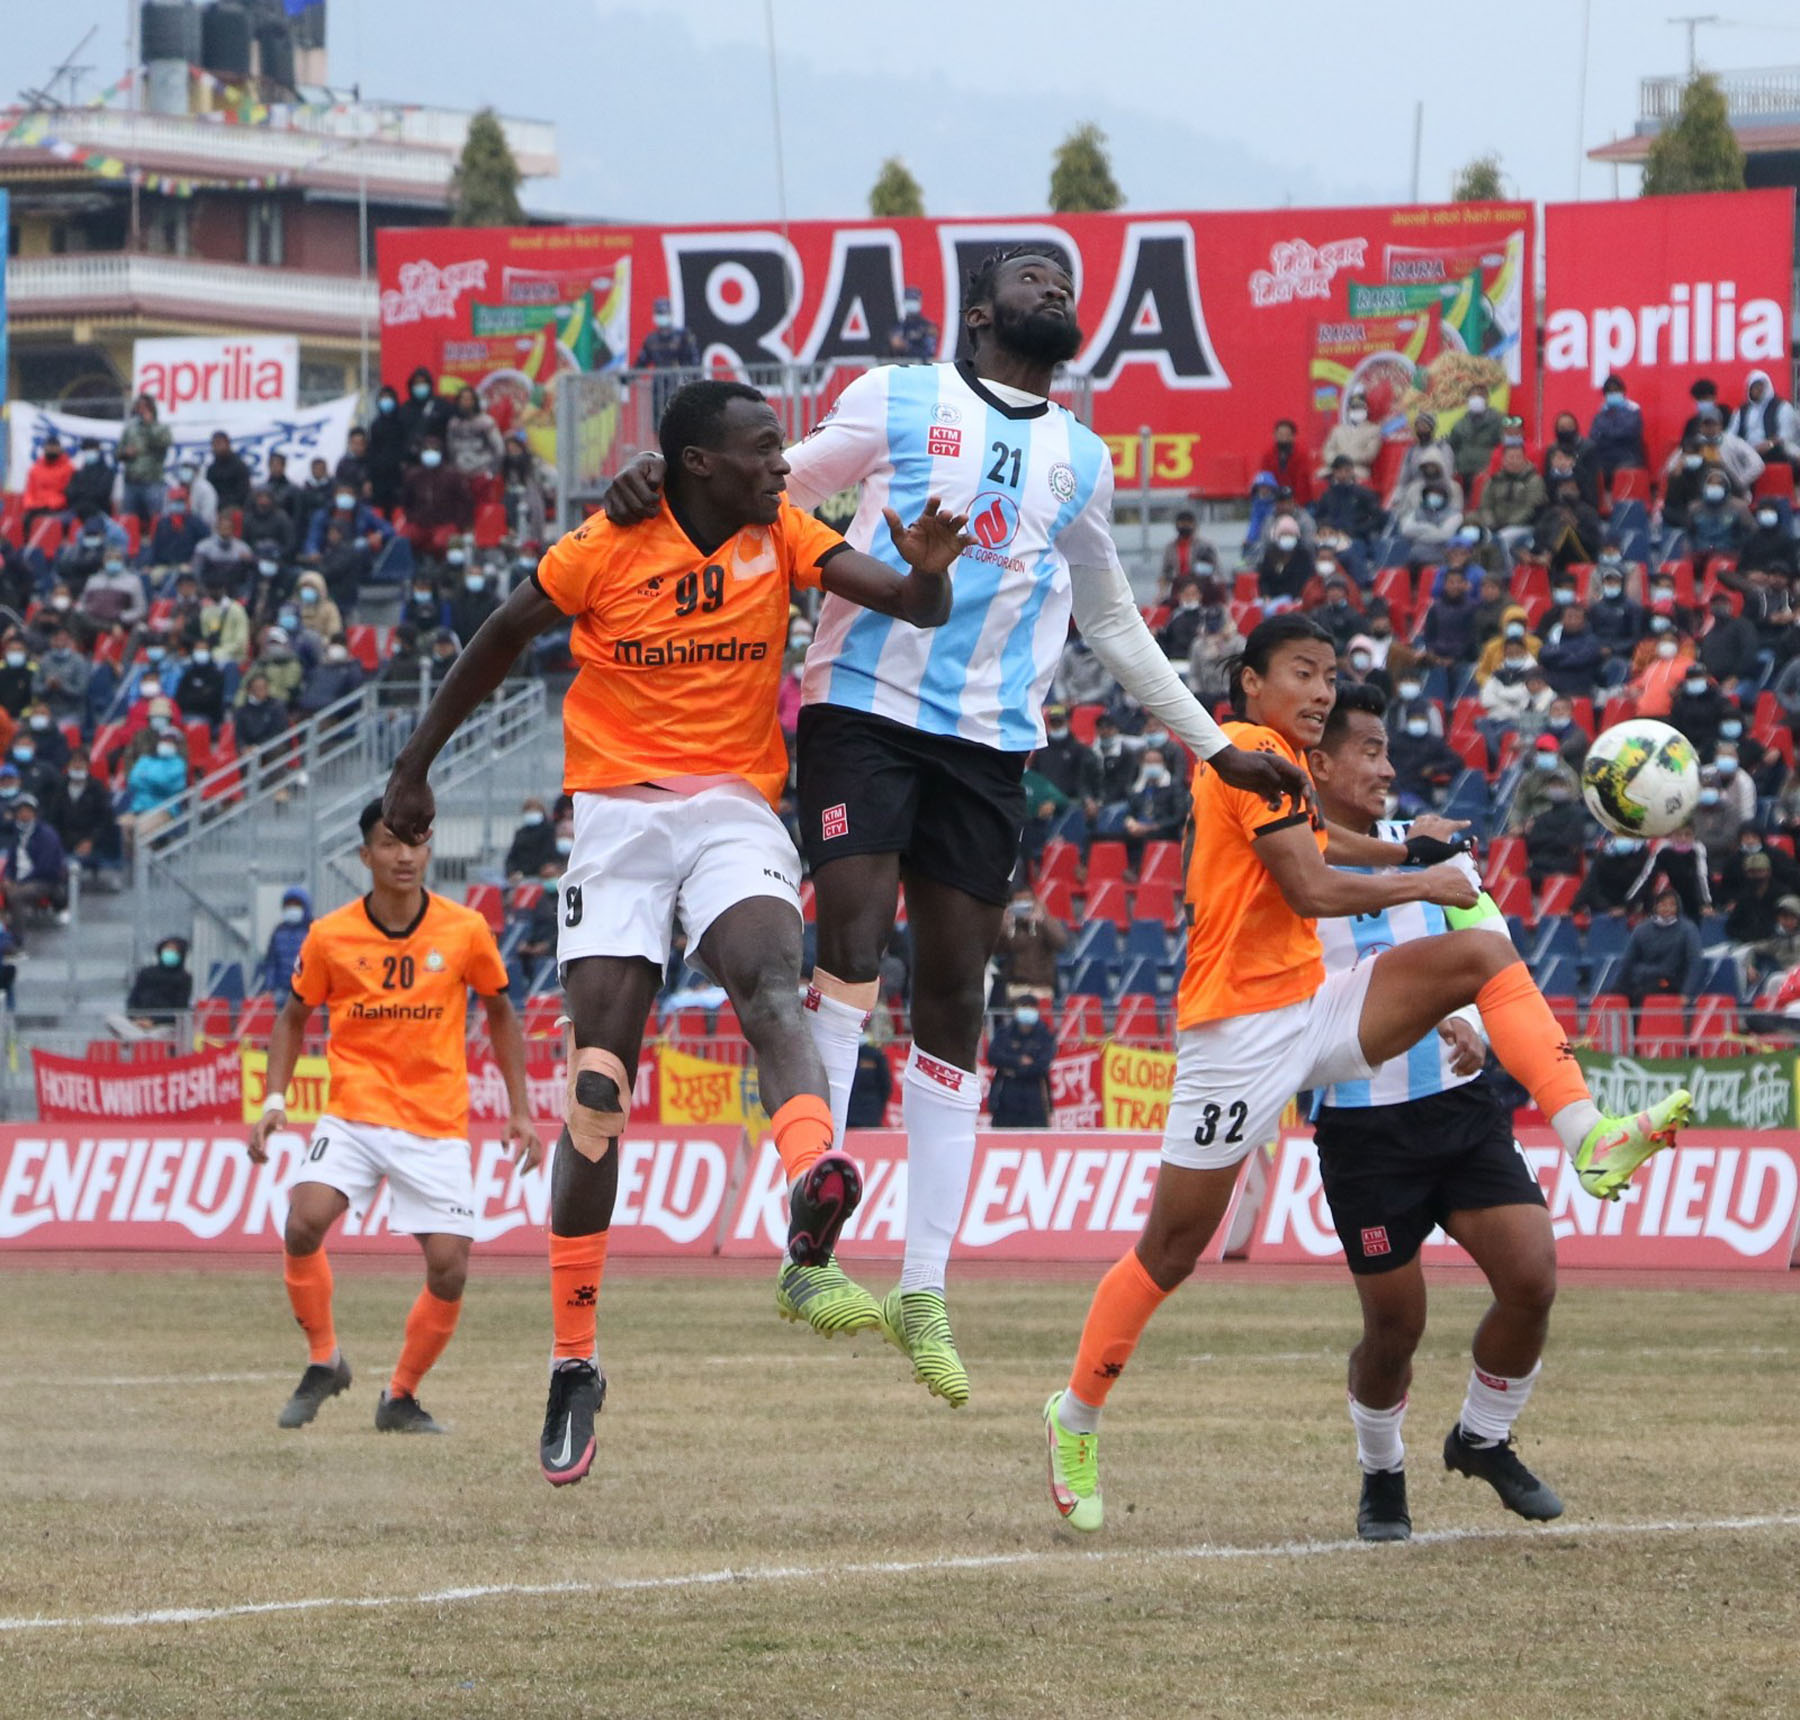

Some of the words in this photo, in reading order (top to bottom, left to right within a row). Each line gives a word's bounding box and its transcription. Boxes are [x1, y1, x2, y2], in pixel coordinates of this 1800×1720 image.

[1545, 280, 1785, 389] aprilia
[138, 345, 284, 413] aprilia
[931, 427, 960, 441] KTM
[931, 443, 956, 454] CTY
[986, 441, 1022, 488] 21
[675, 564, 725, 616] 99
[614, 636, 768, 666] Mahindra
[825, 807, 844, 823] KTM
[825, 822, 843, 837] CTY
[381, 955, 415, 990] 20
[40, 1066, 101, 1116] HOTEL
[100, 1073, 168, 1117] WHITE
[167, 1063, 217, 1114] FISH
[1112, 1096, 1170, 1129] TRA
[1194, 1100, 1248, 1146] 32
[0, 1139, 250, 1239] ENFIELD
[470, 1139, 727, 1243] ENELD
[958, 1149, 1164, 1247] ENFIE
